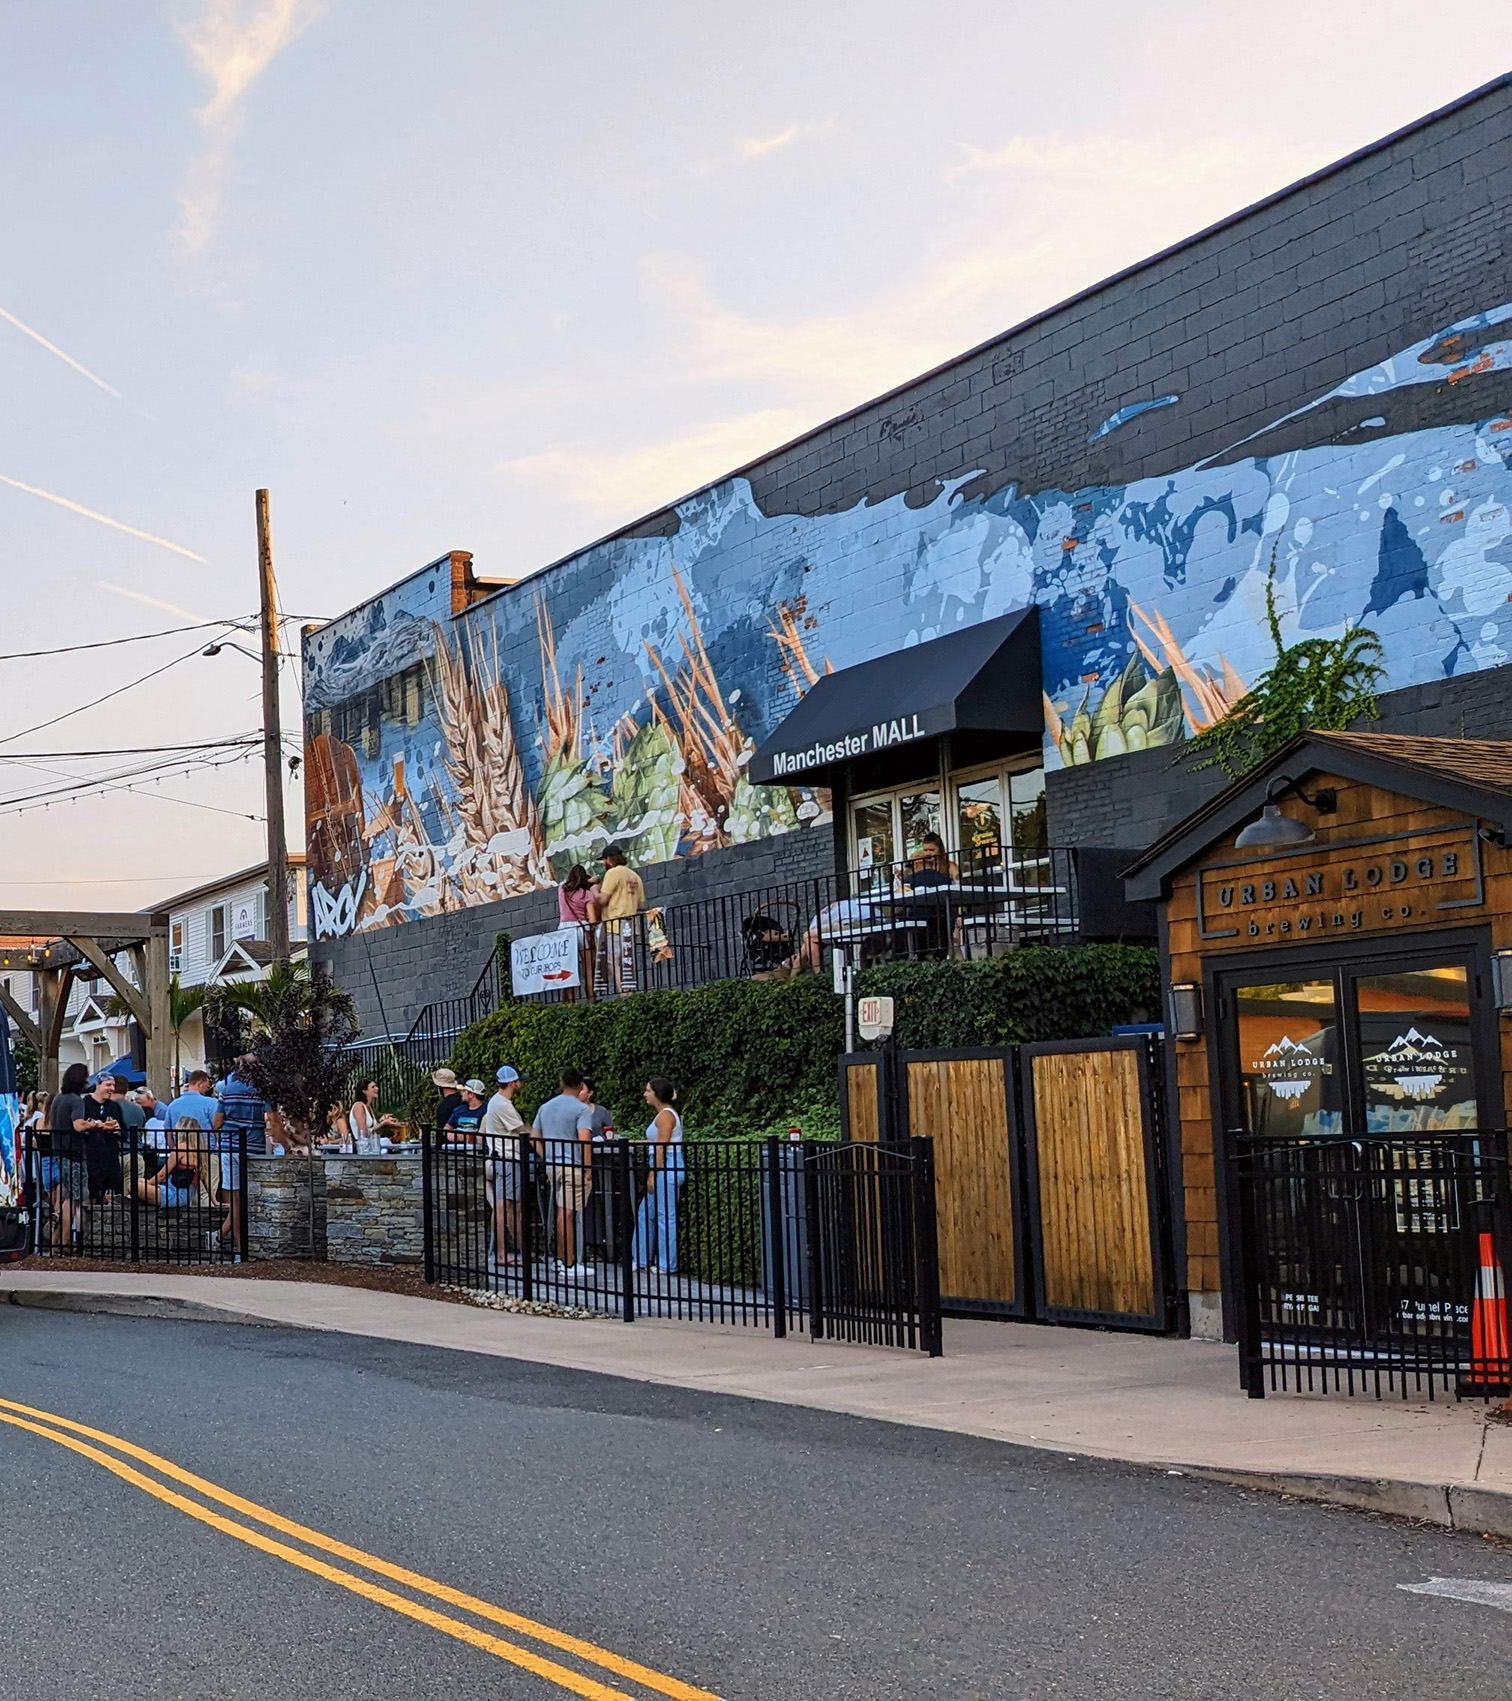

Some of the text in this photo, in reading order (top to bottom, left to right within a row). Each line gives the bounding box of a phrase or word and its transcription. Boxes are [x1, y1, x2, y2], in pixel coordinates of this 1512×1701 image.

[773, 714, 925, 776] Manchester MALL
[1218, 852, 1457, 907] URBAN LODGE
[1248, 905, 1426, 937] brewing co.
[515, 940, 569, 965] WELCOME
[863, 1001, 876, 1022] EXIT
[1252, 1057, 1325, 1069] URBAN LODGE
[1376, 1050, 1458, 1063] URBAN LODGE
